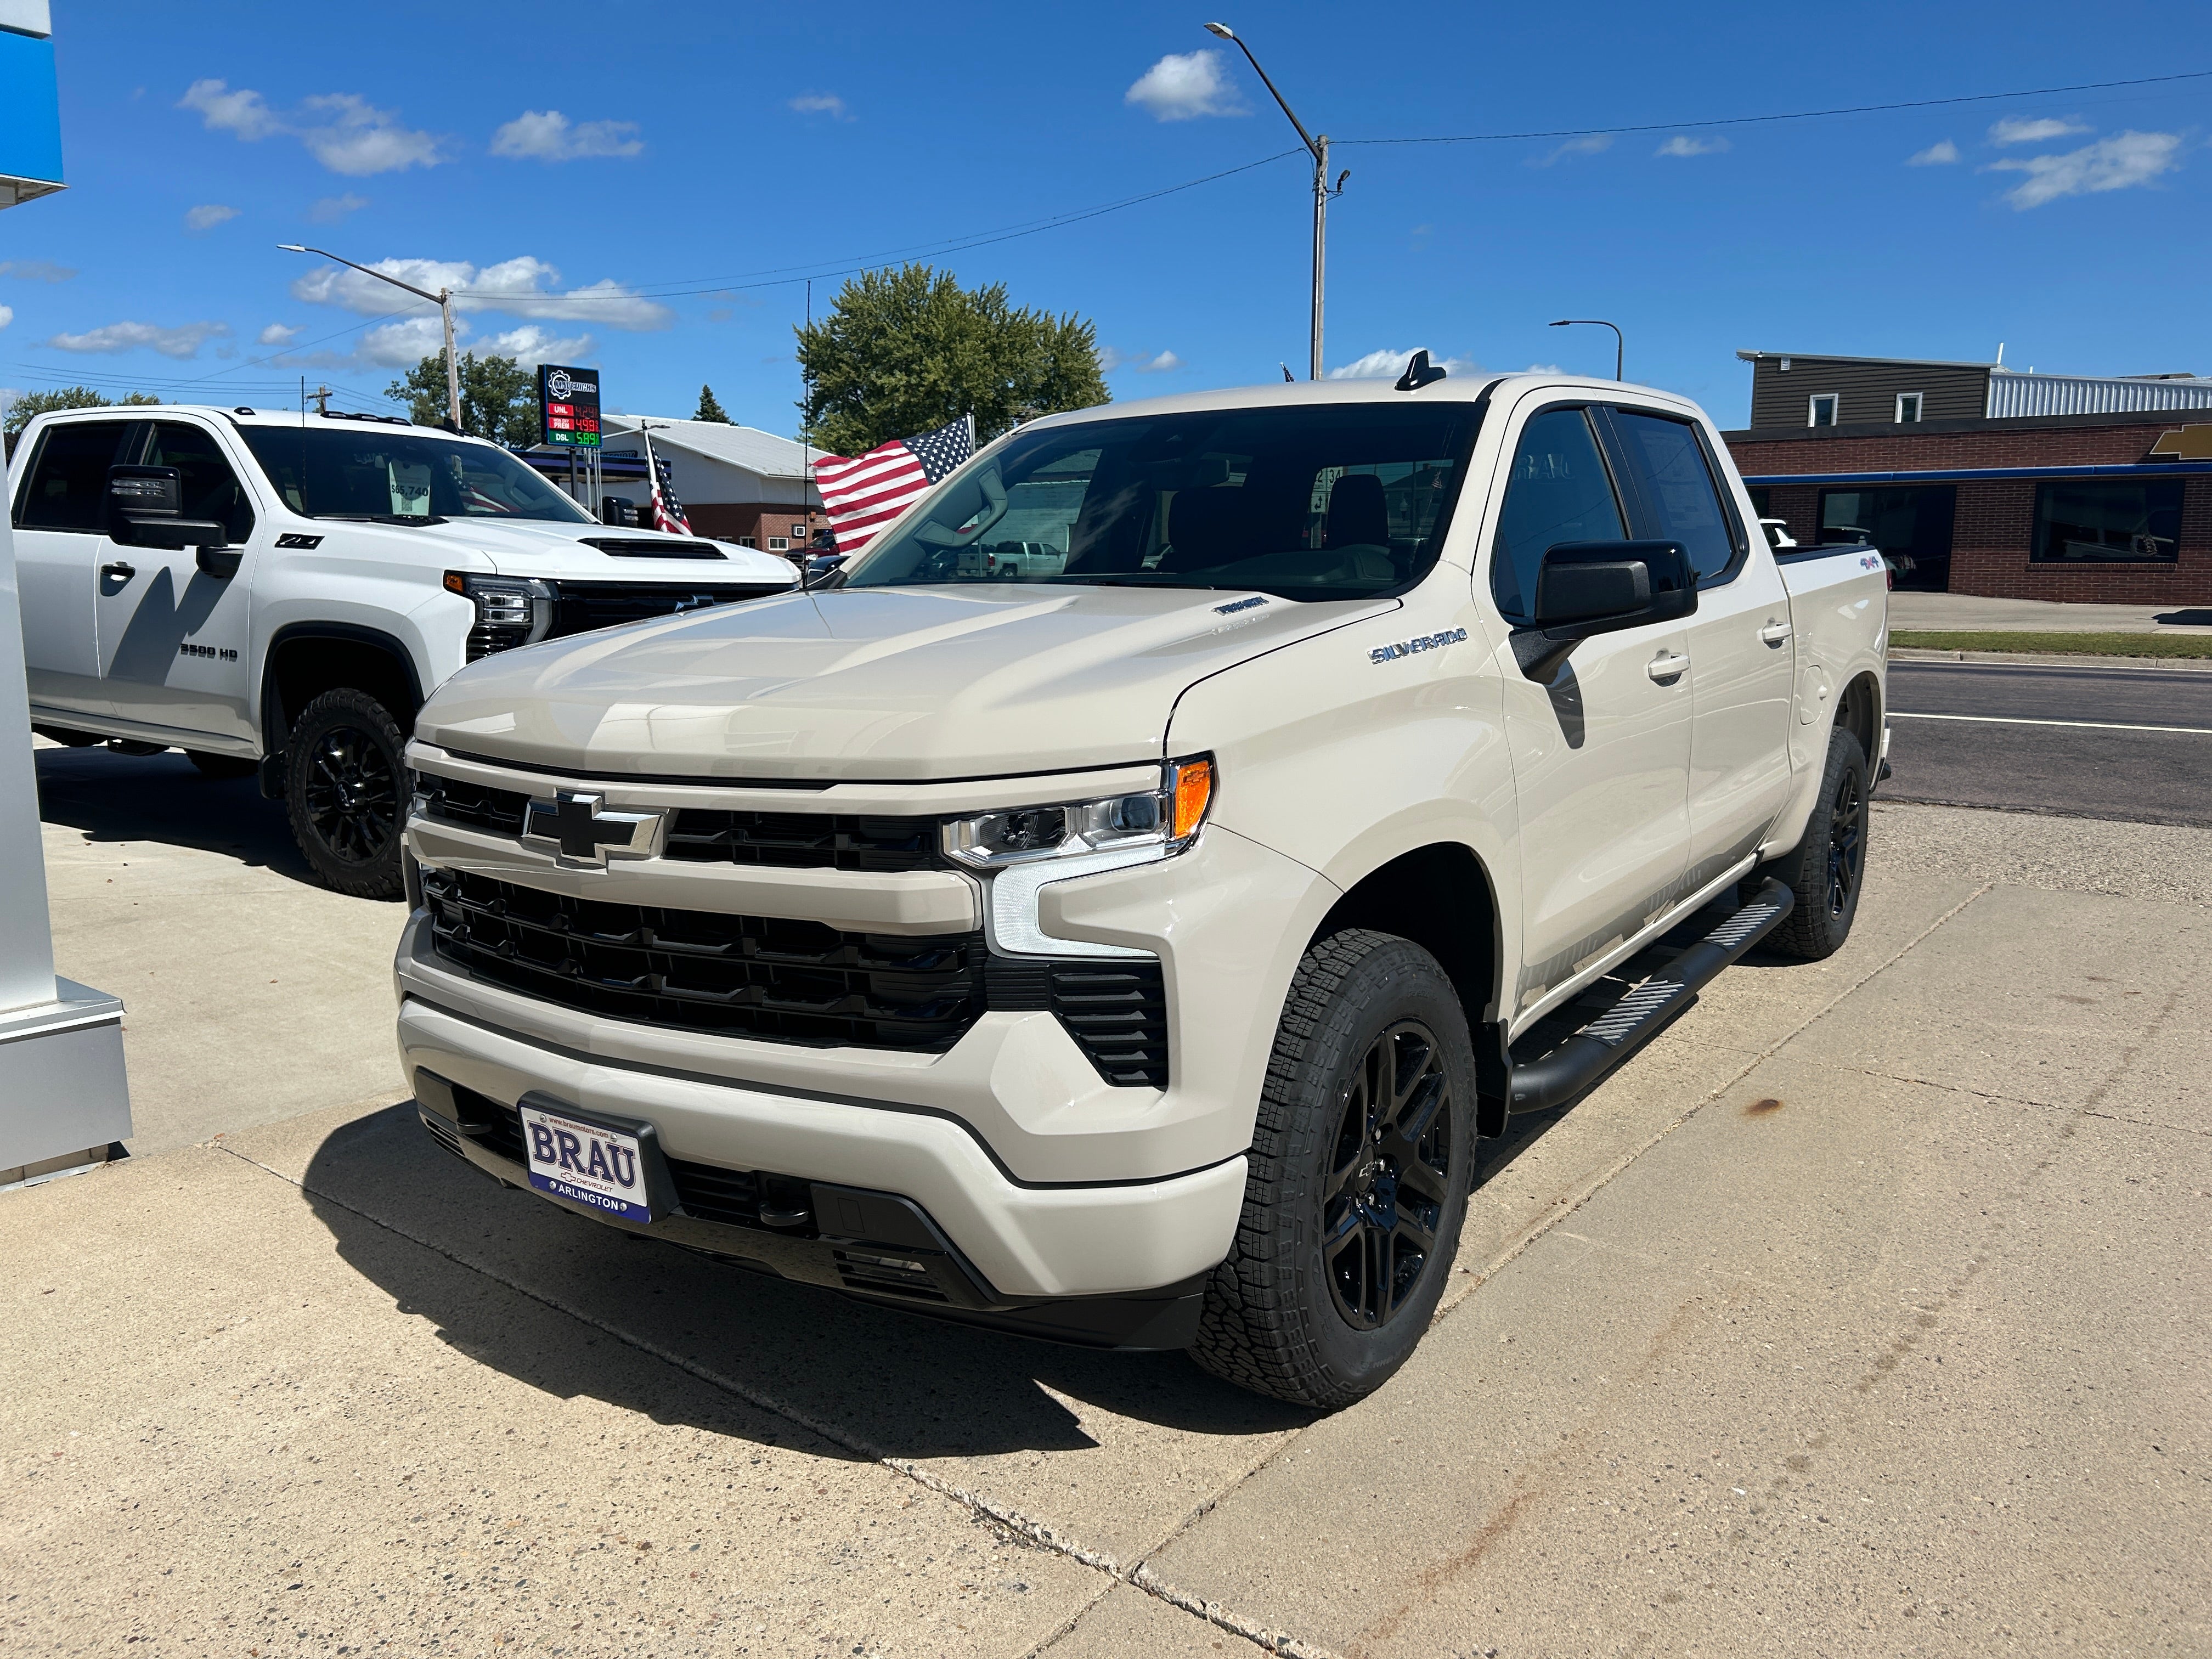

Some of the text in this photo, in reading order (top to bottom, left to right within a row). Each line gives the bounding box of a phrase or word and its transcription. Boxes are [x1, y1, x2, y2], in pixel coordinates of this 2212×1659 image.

[554, 405, 568, 414] UNL
[556, 433, 569, 442] DSL
[391, 484, 428, 496] $65,740
[180, 643, 238, 658] 3500 HD
[1367, 628, 1468, 664] SILVERADO
[549, 1117, 609, 1139] www.braumotors.com
[527, 1120, 636, 1189] BRAU
[577, 1178, 613, 1193] CHEVROLET
[558, 1184, 618, 1210] ARLINGTON
